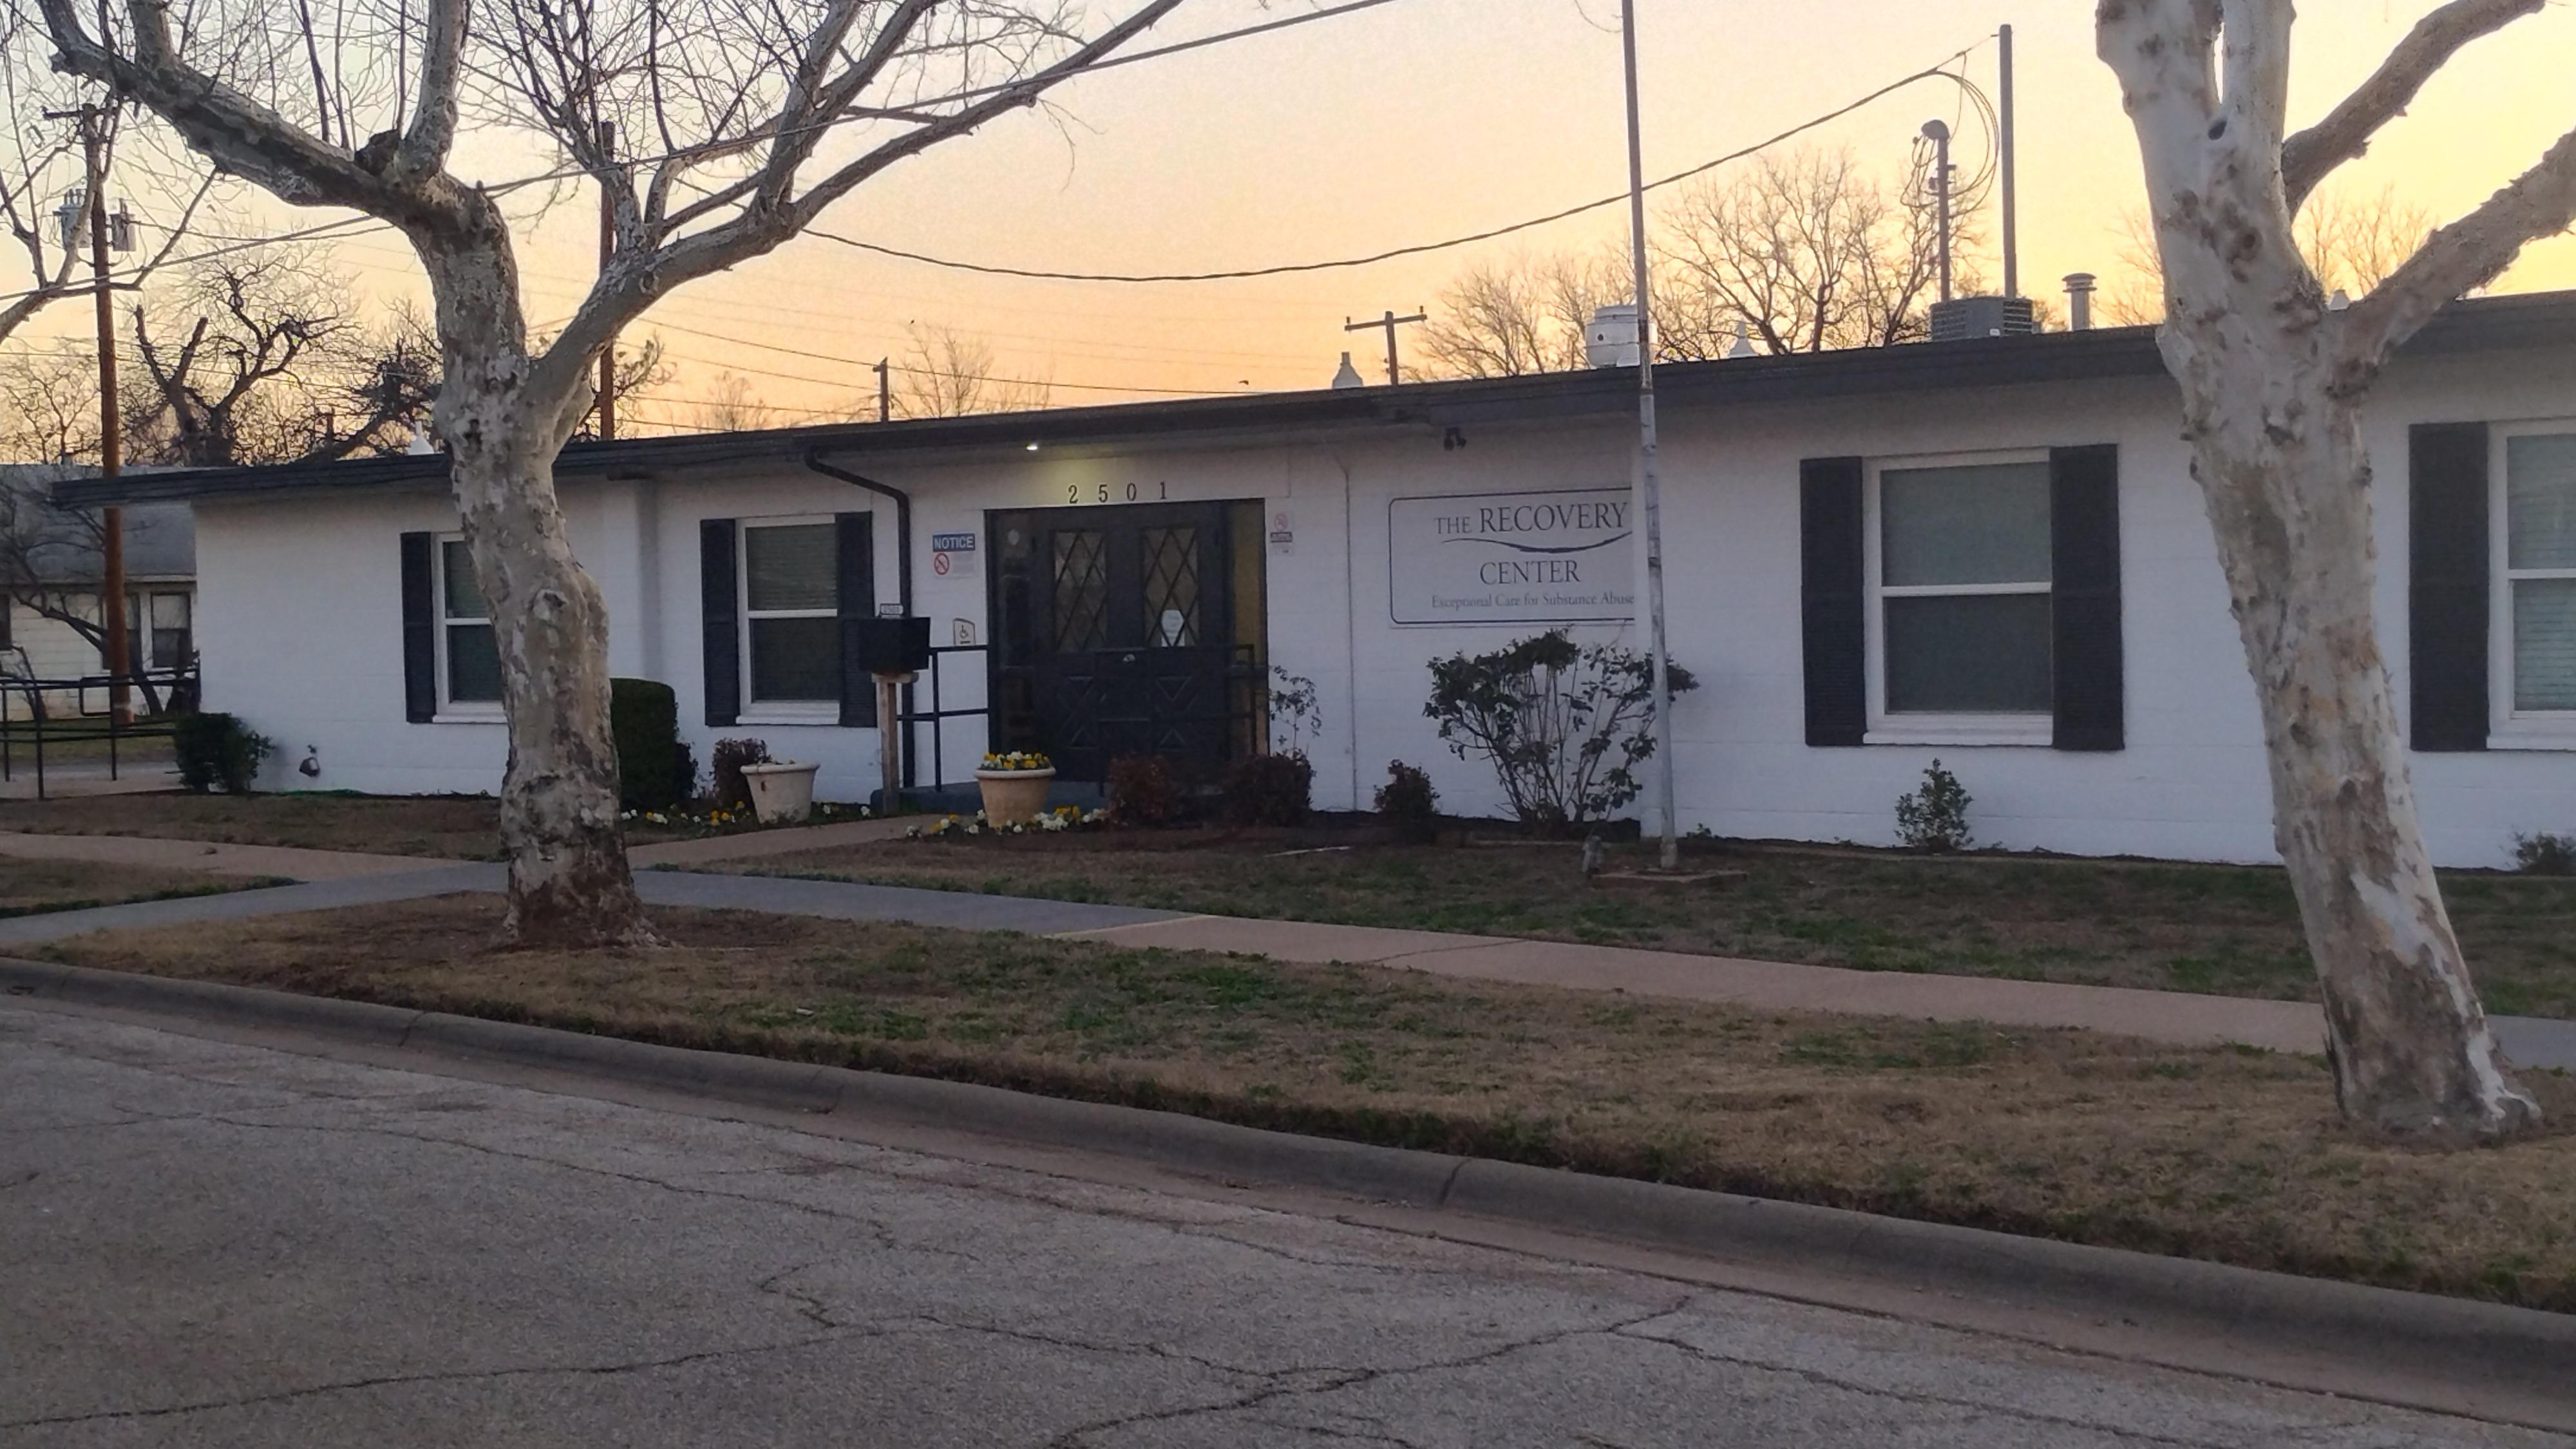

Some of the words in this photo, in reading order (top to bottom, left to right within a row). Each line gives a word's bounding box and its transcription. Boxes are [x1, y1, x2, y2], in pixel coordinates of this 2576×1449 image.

[1068, 482, 1168, 504] 2501
[1434, 516, 1472, 534] THE
[1479, 502, 1628, 533] RECOVERY
[934, 536, 974, 549] NOTICE
[1479, 560, 1580, 585] CENTER
[1432, 594, 1492, 610] Exceptional
[1495, 595, 1519, 607] Care
[1524, 592, 1539, 606] for
[1543, 592, 1597, 605] Substance
[1600, 592, 1635, 605] Abuse
